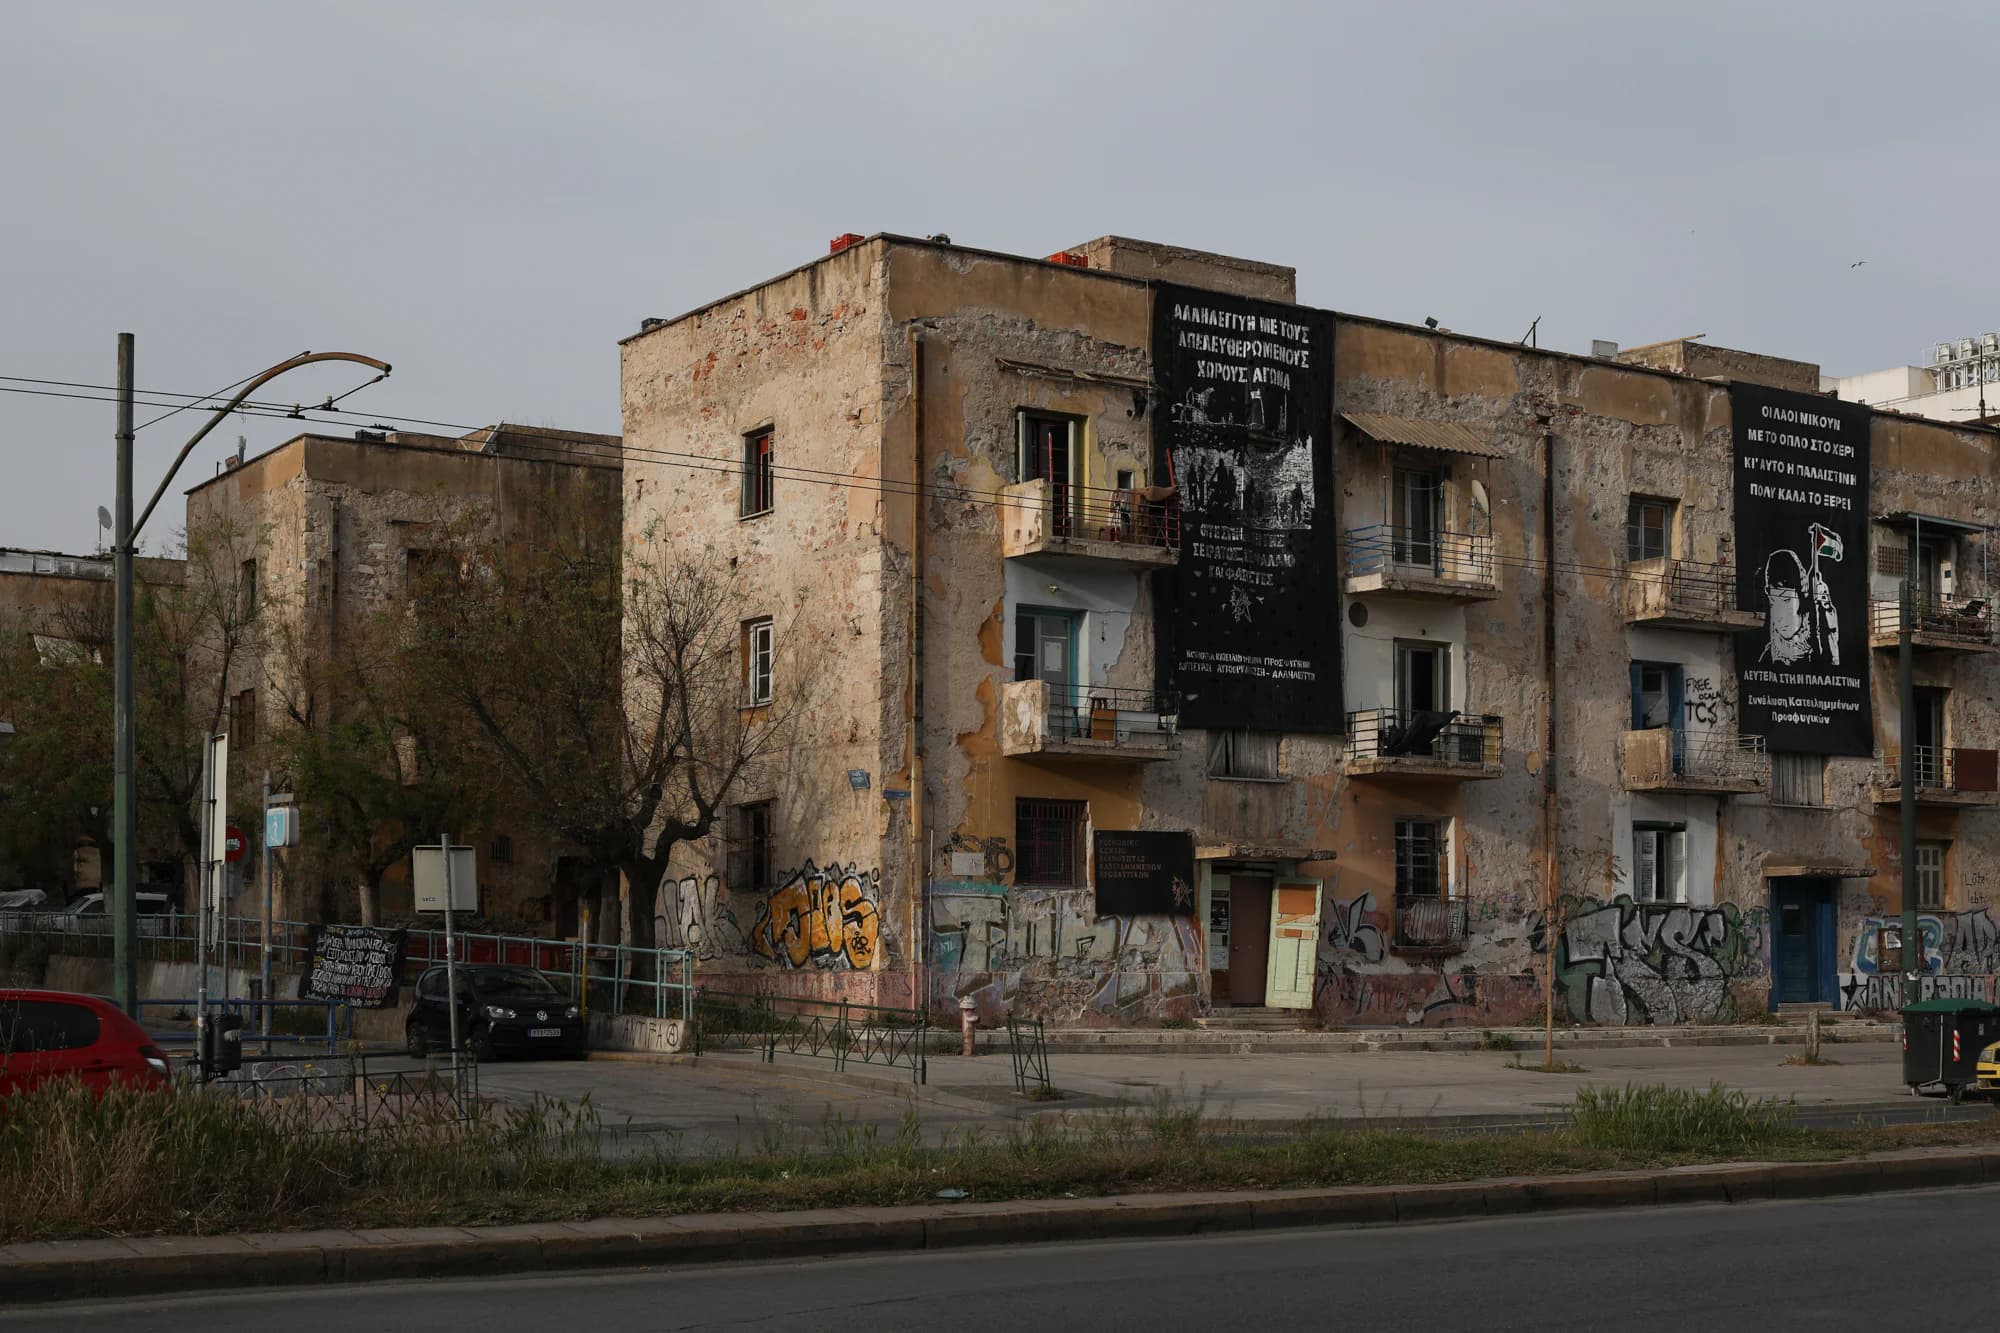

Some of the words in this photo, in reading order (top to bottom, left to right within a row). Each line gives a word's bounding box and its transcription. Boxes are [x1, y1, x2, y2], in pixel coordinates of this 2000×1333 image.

[1174, 303, 1256, 332] ΑΛΛΗΛΕΓΓΥΗ
[1259, 316, 1278, 335] ΜΕ
[1279, 320, 1310, 344] ΤΟΥΣ
[1197, 360, 1248, 383] ΧΩΡΟΥΣ
[1252, 367, 1290, 391] ΑΓΩΝΑ
[1761, 405, 1772, 418] ΟΙ
[1773, 407, 1798, 423] ΛΑΟΙ
[1800, 411, 1841, 431] ΝΙΚΟΥΝ
[1747, 428, 1764, 442] ΜΕ
[1765, 430, 1777, 444] ΤΟ
[1779, 433, 1808, 449] ΟΠΛΟ
[1810, 438, 1831, 454] ΣΤΟ
[1832, 443, 1855, 458] ΧΕΡΙ
[1759, 458, 1785, 473] ΑΥΤΟ
[1786, 462, 1794, 475] Η
[1796, 465, 1857, 486] ΠΑΛΑΙΣΤΙΝΗ
[1750, 483, 1776, 499] ΠΟΛΥ
[1778, 487, 1806, 503] ΚΑΛΑ
[1808, 491, 1822, 505] ΤΟ
[1823, 494, 1851, 511] ΞΕΡΕΙ
[1685, 677, 1713, 694] FREE
[1779, 673, 1805, 685] ΣΤΗΝ
[1805, 675, 1860, 689] ΠΑΛΑΙΣΤΙΝΗ
[1788, 696, 1860, 711] Κατειλημμένων
[623, 1018, 663, 1049] ANTIFA
